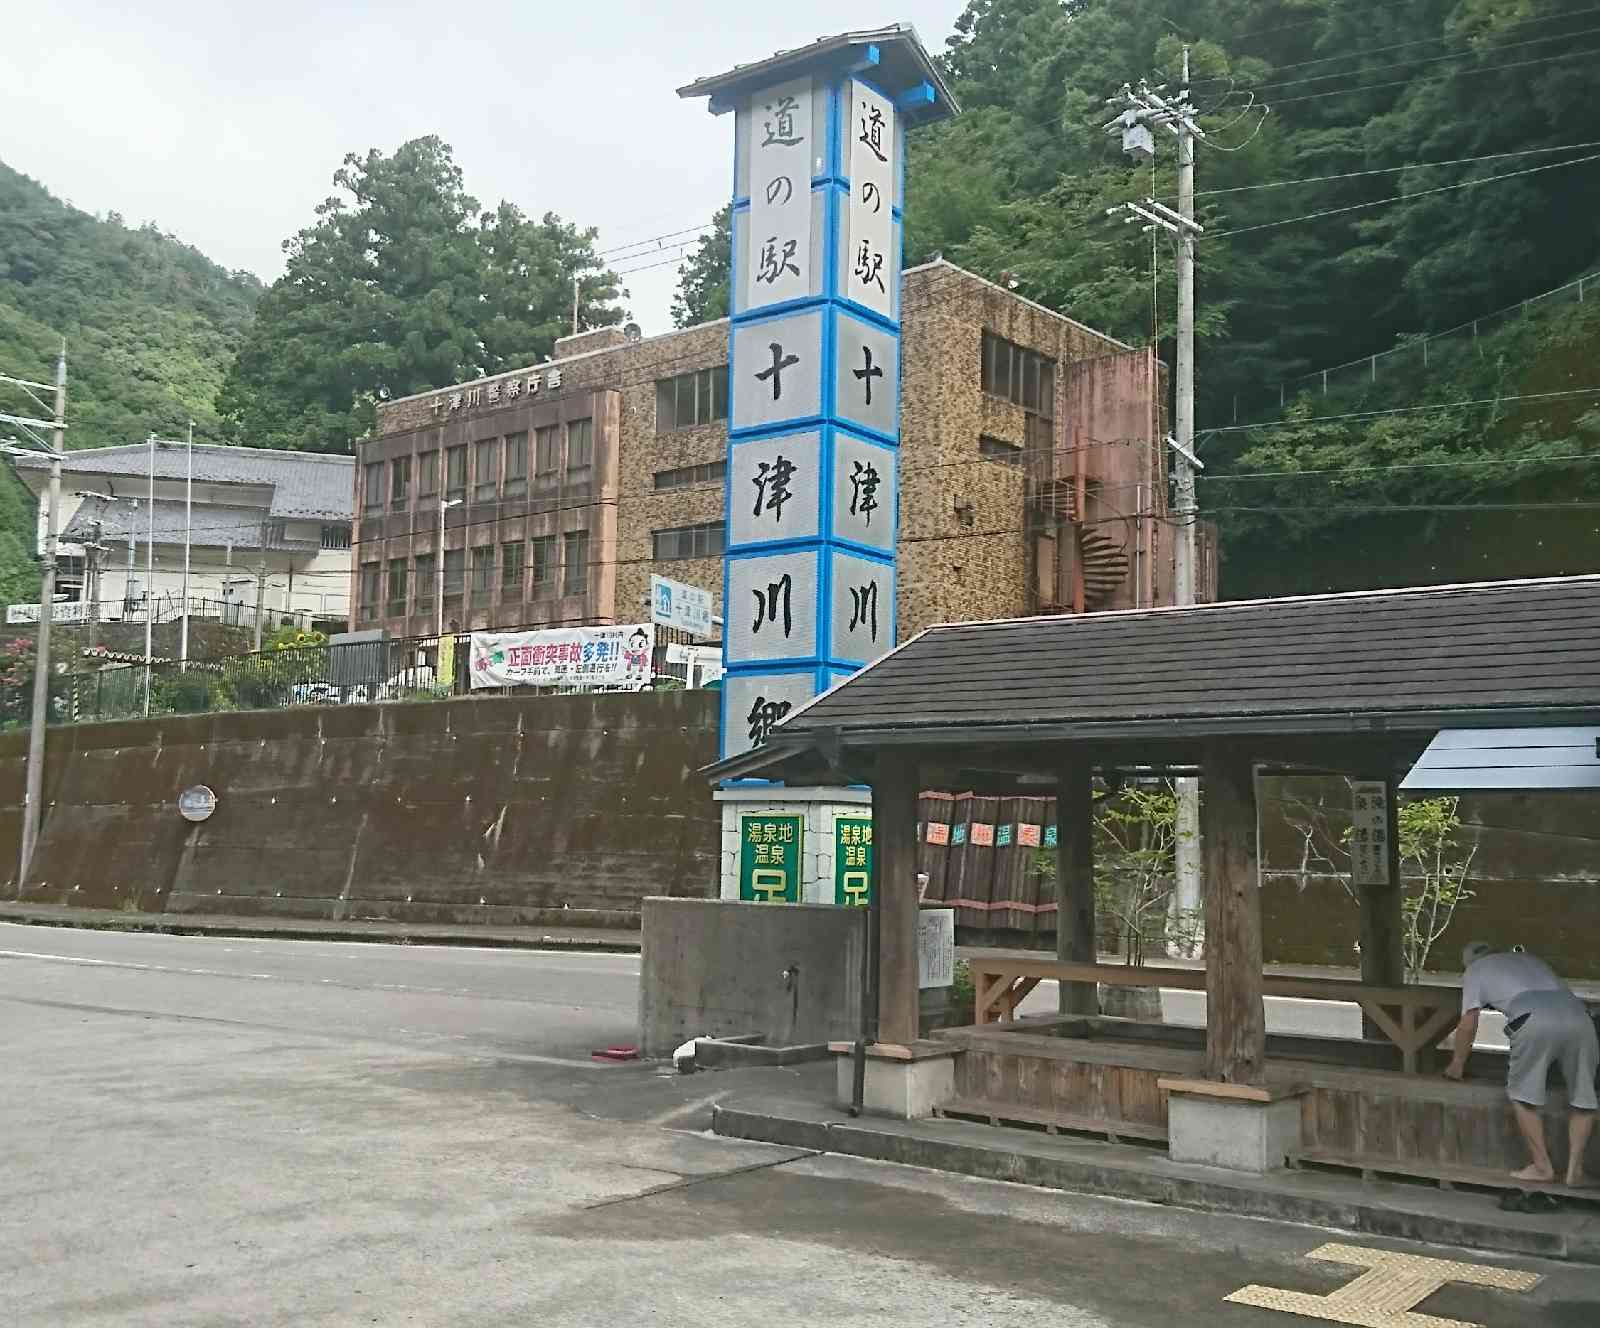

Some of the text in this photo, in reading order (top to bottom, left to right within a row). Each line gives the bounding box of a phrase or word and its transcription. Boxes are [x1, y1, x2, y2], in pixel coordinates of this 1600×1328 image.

[756, 96, 804, 286] 道の駅
[849, 101, 888, 644] 道の駅 十津川
[747, 822, 793, 843] 湯泉地
[840, 824, 872, 845] 湯泉地
[754, 843, 785, 865] 温泉
[845, 846, 867, 866] 温泉
